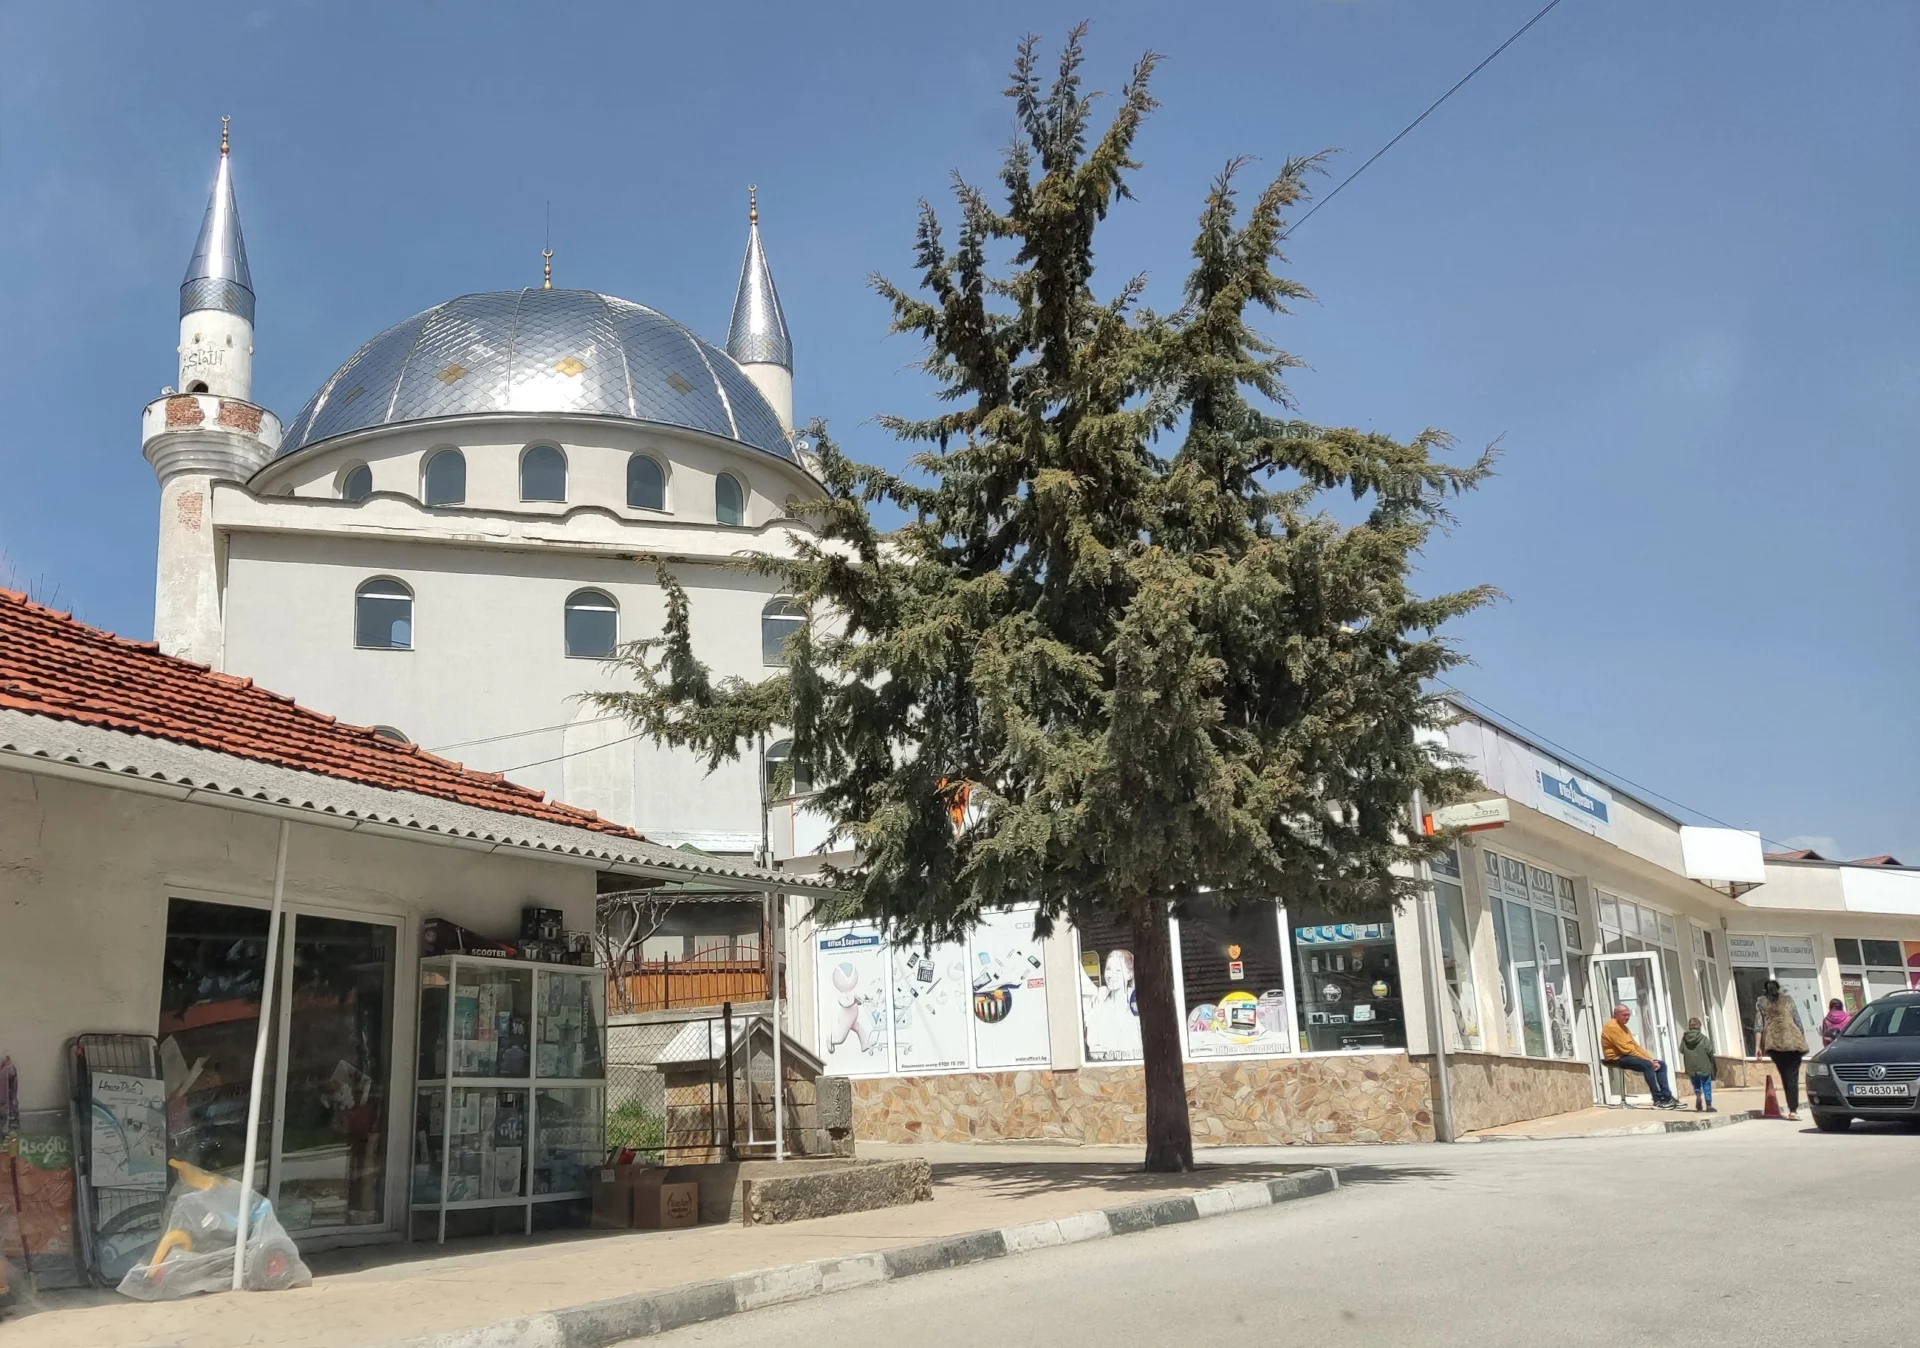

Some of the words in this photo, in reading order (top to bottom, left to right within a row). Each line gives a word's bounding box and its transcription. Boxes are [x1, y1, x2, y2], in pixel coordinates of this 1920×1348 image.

[471, 948, 507, 958] SCOOTER
[1854, 1086, 1867, 1095] CB
[1868, 1086, 1892, 1095] 4830
